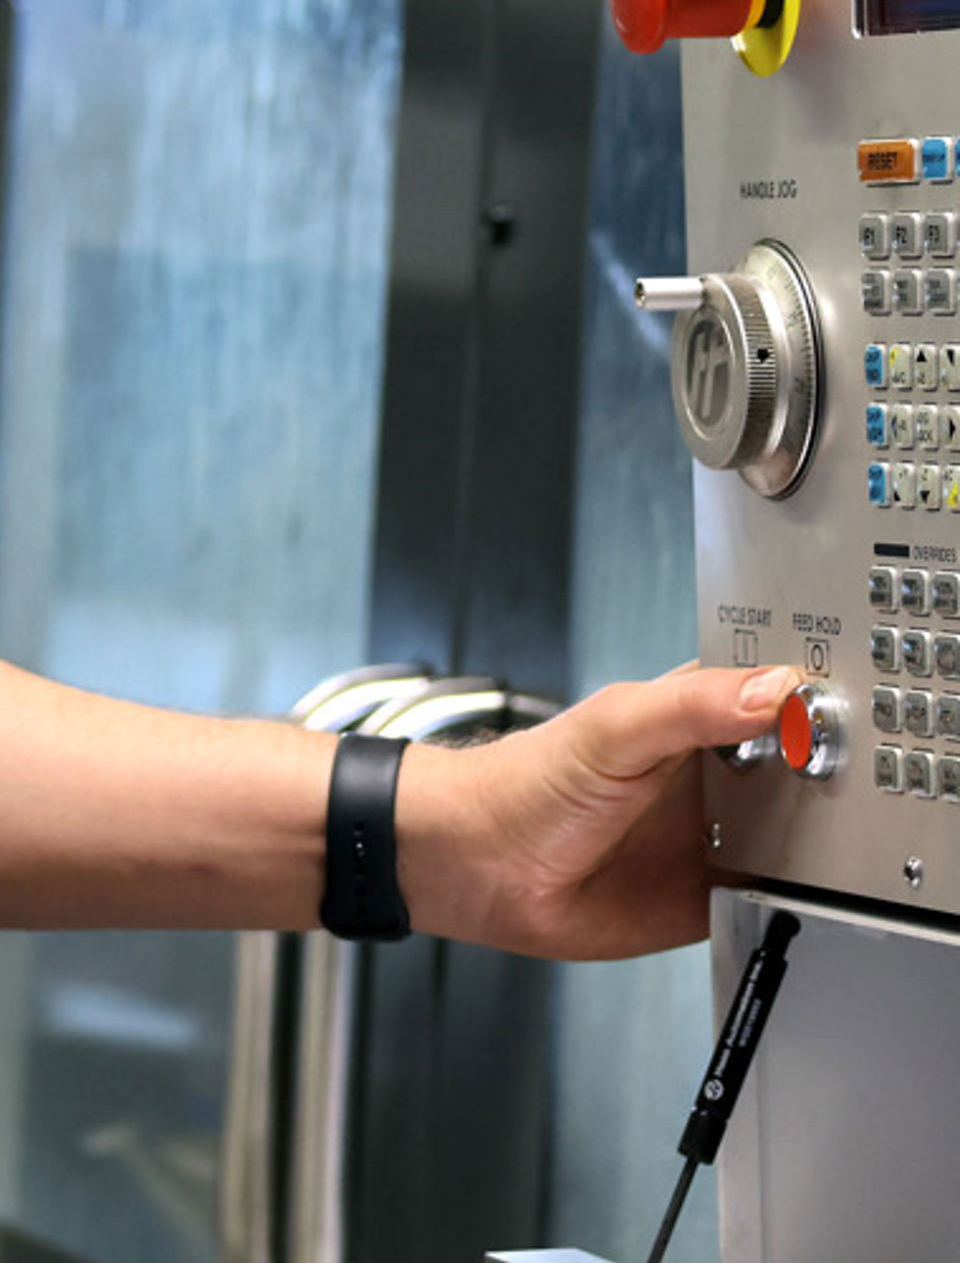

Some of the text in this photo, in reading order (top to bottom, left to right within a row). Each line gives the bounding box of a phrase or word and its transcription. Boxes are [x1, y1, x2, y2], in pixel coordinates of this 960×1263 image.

[868, 152, 898, 170] RESET
[740, 179, 797, 199] HANDLE JOG
[895, 226, 907, 244] F2
[928, 224, 940, 243] F3
[718, 604, 771, 628] CYCLE START
[792, 612, 842, 636] FEED HOLD
